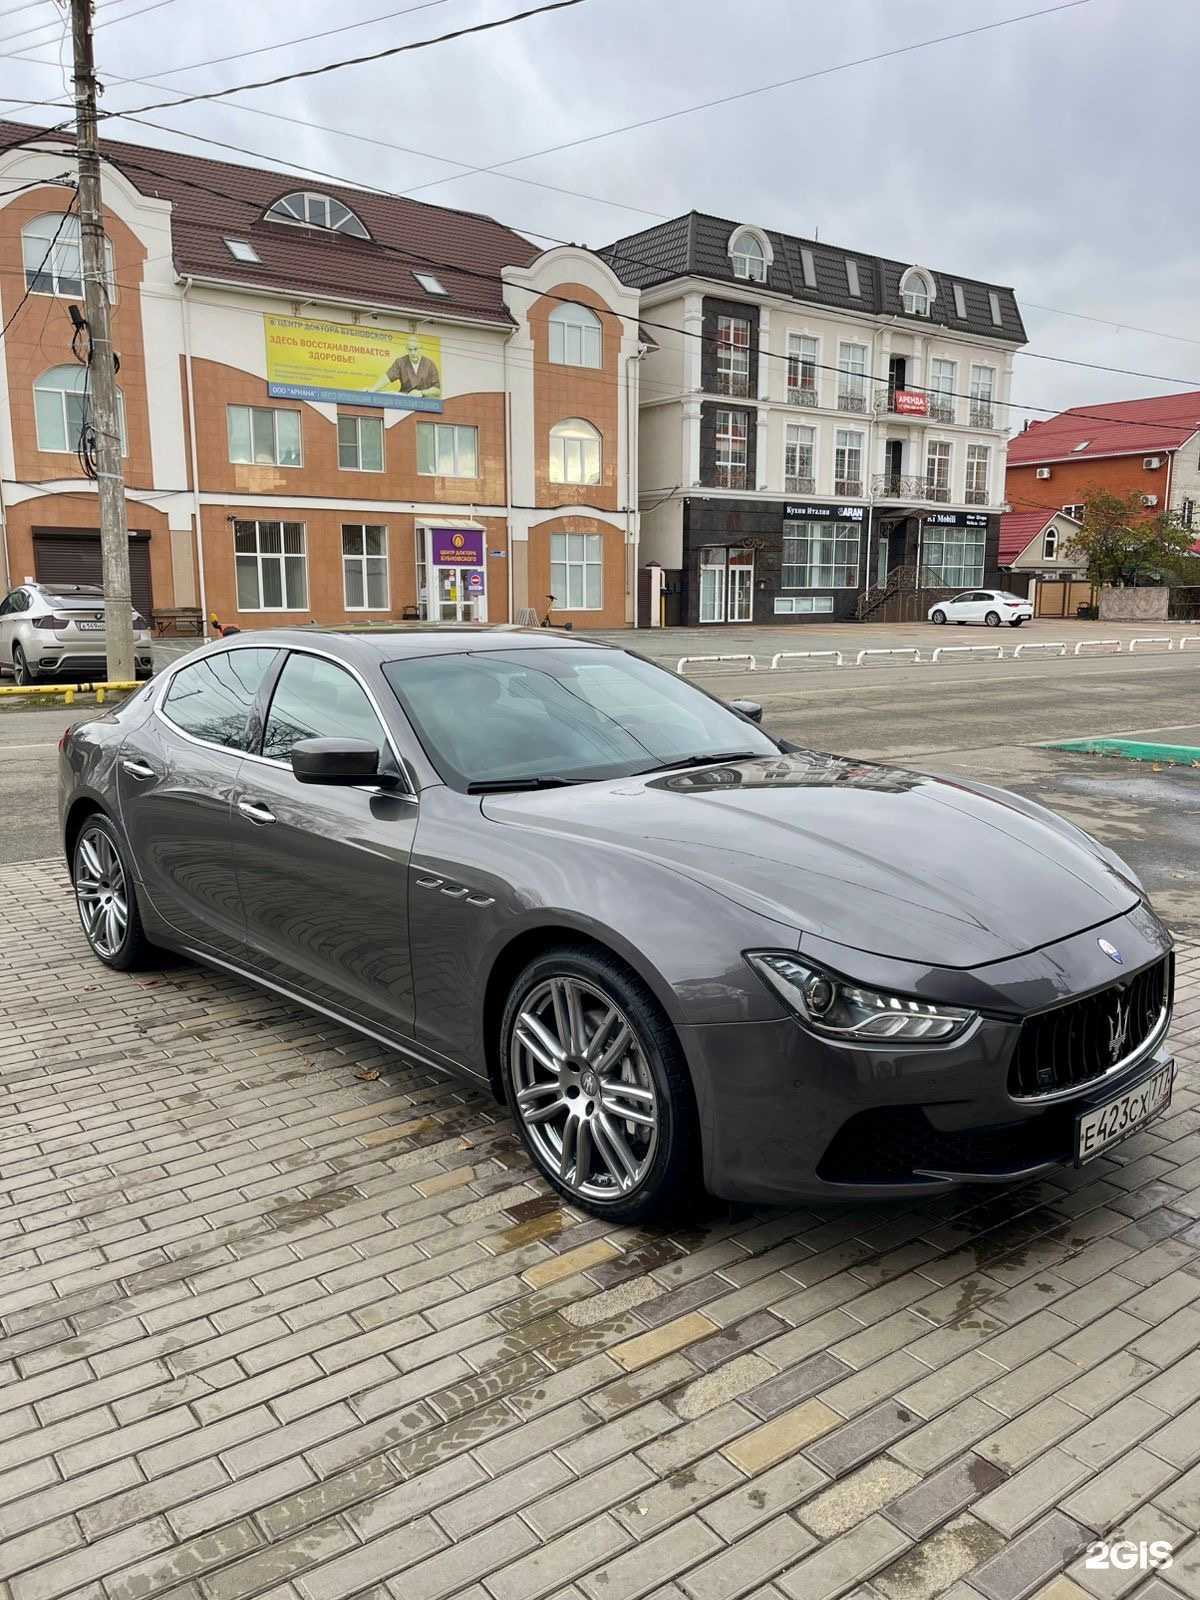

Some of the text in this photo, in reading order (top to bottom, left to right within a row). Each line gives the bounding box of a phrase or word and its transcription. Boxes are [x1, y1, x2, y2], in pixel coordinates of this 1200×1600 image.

[270, 336, 391, 358] ЗДЕСЬ ВОССТАНАВЛИВАЕТСЯ
[309, 351, 356, 364] ЗДОРОВЬЕ!
[272, 386, 287, 395] ООО
[843, 506, 863, 516] ARAN
